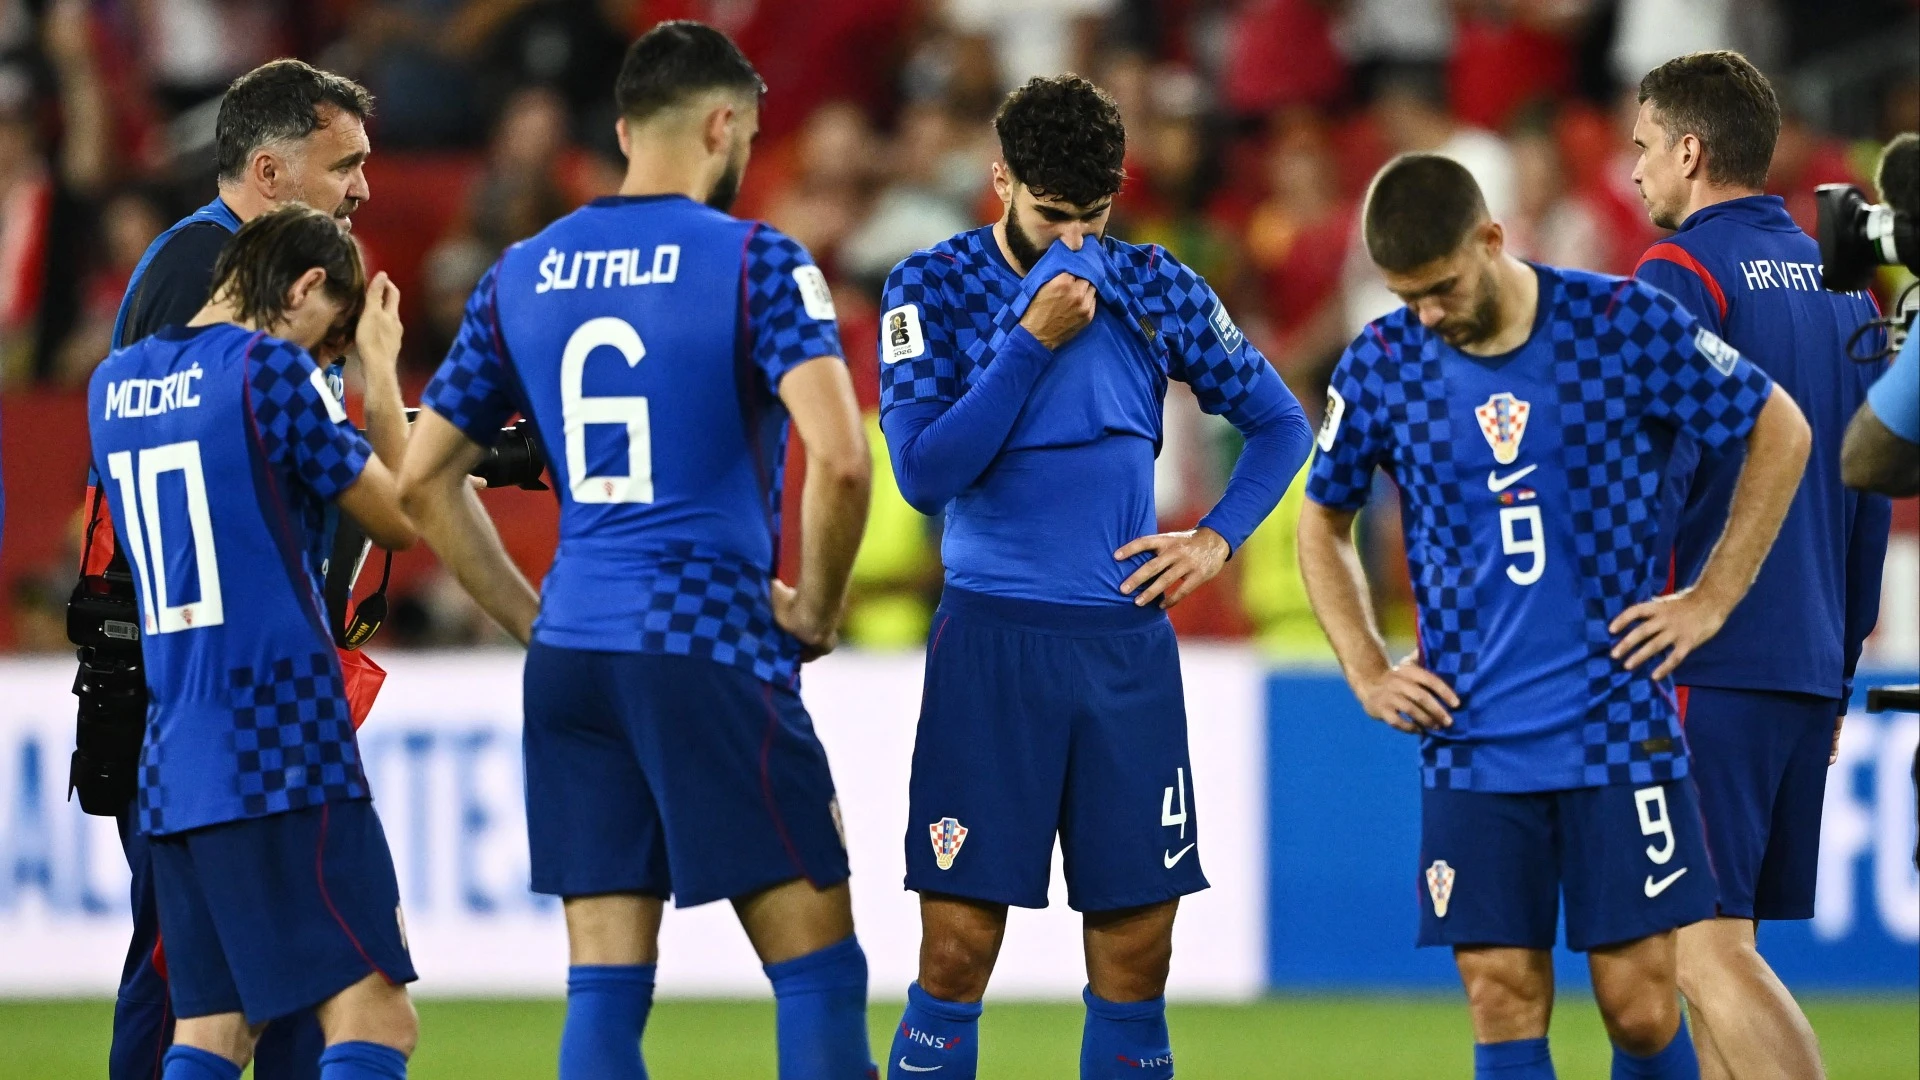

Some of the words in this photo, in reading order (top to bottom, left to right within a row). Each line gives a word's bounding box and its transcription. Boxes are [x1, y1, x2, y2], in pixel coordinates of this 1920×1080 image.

[1740, 259, 1862, 300] HRVAT
[105, 361, 204, 420] MODRIĆ
[560, 316, 654, 504] 6
[107, 440, 225, 636] 10
[1499, 504, 1547, 586] 9
[1161, 767, 1187, 839] 4
[1633, 785, 1676, 865] 9
[909, 1027, 946, 1049] HNS
[1140, 1052, 1175, 1069] HNS
